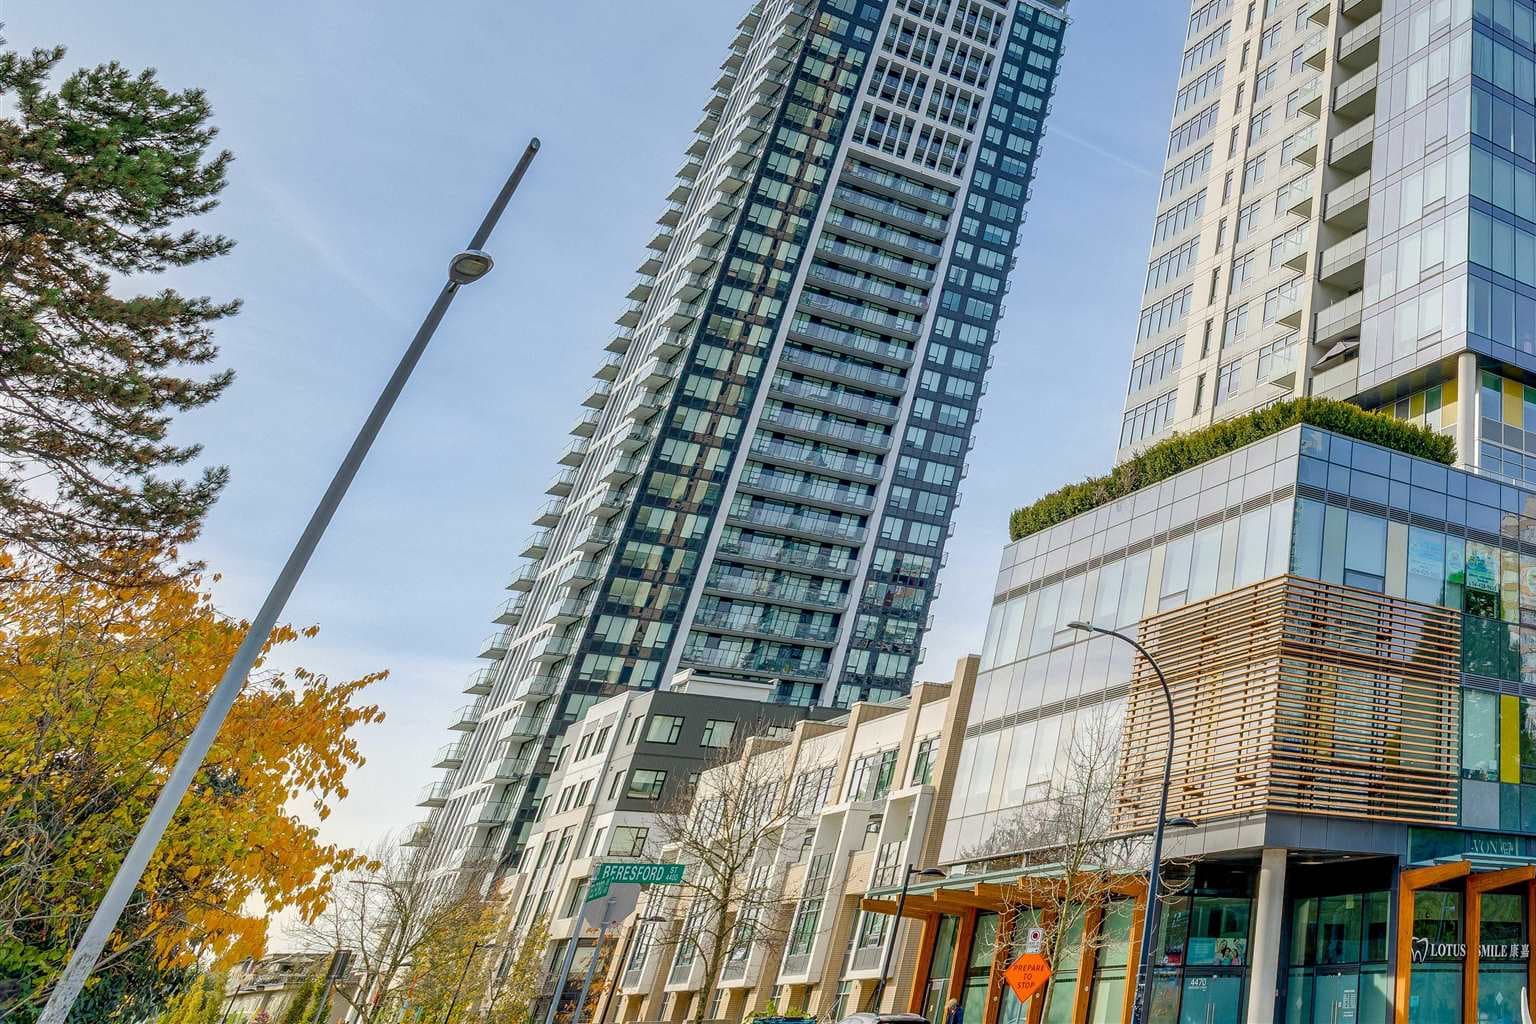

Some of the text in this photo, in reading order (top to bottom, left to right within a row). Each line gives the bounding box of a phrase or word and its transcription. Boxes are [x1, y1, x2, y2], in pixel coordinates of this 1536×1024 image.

[602, 865, 679, 881] BERESFORD ST
[1431, 943, 1466, 957] LOTUS
[1013, 964, 1044, 972] PREPARE
[1023, 973, 1033, 981] TO
[1017, 981, 1035, 989] STOP
[1190, 977, 1207, 986] 4470
